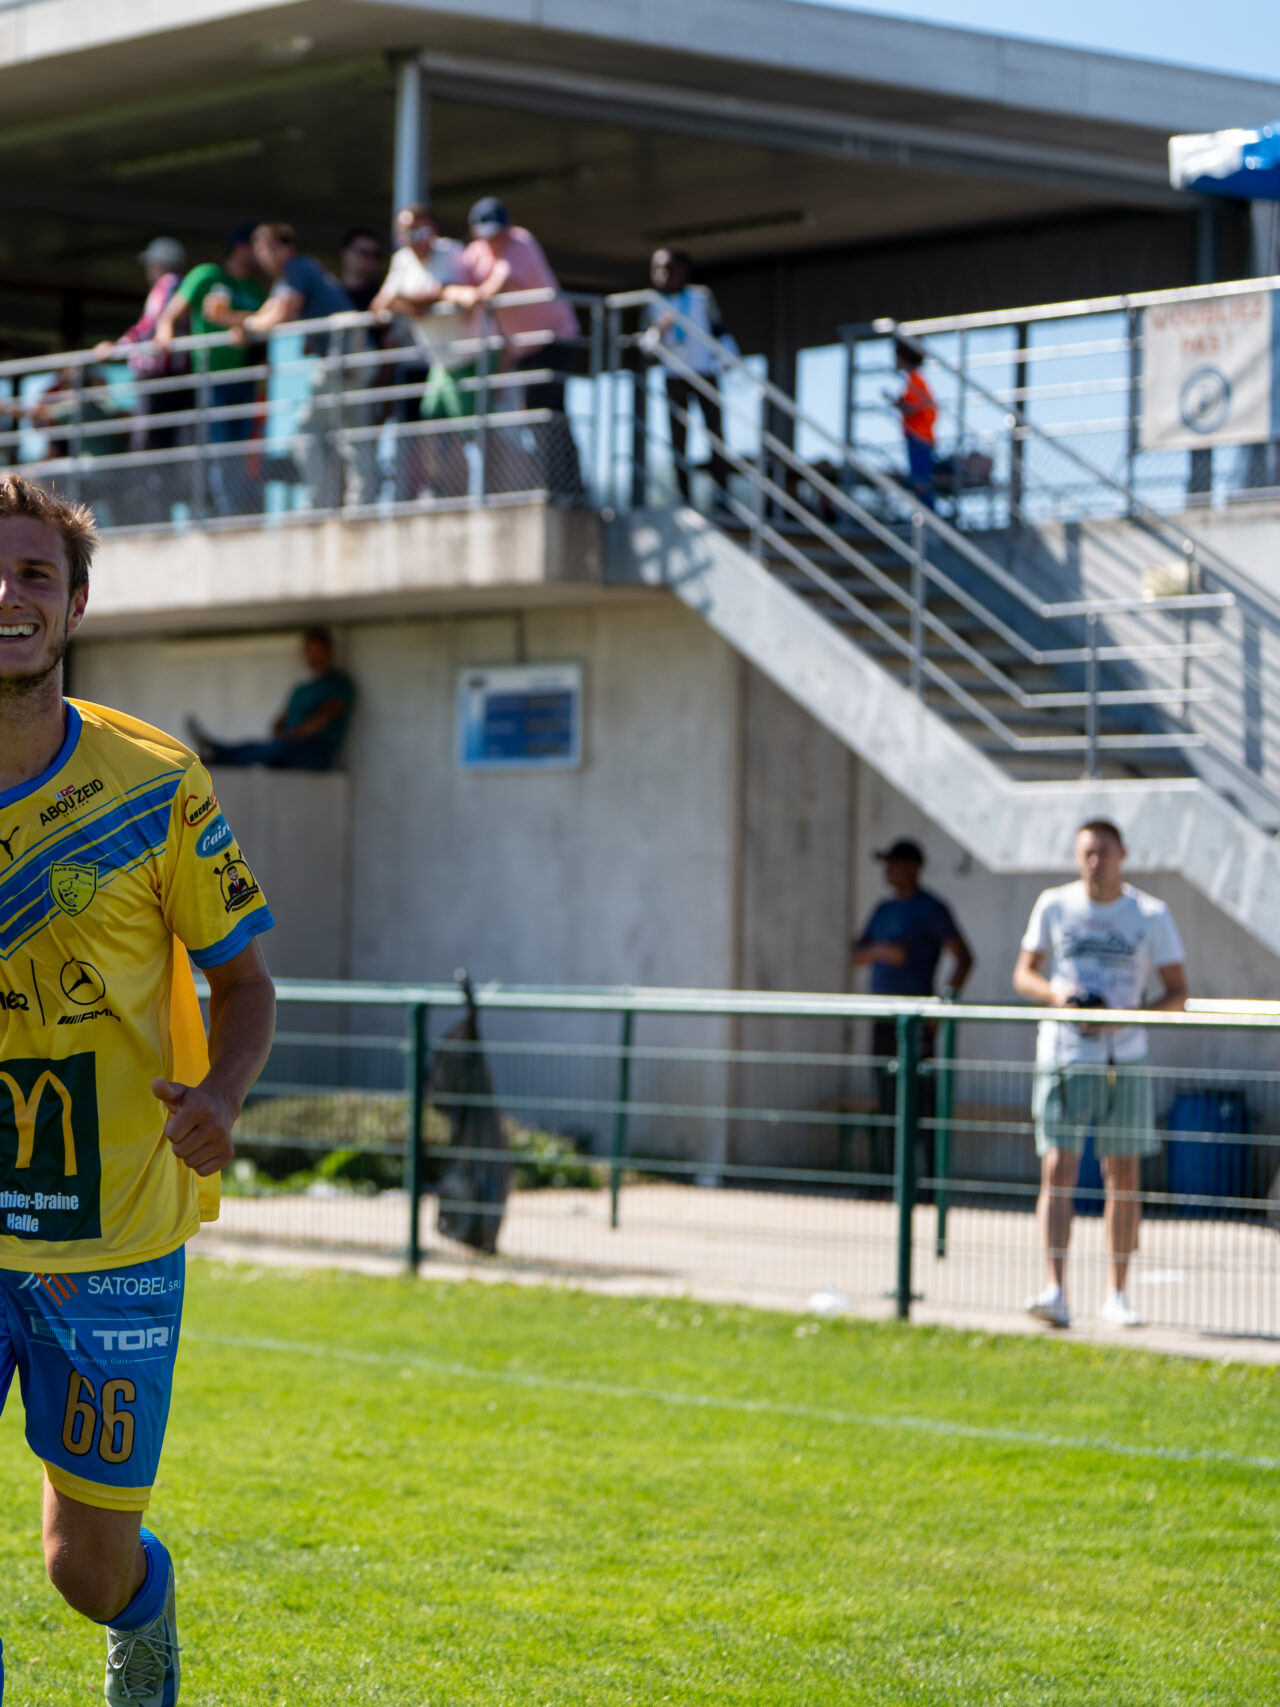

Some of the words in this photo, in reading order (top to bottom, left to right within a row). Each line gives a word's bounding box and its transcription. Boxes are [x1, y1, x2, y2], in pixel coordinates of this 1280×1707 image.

[202, 824, 231, 852] Cair
[6, 1213, 40, 1233] Halle
[87, 1275, 167, 1296] SATOBEL
[61, 1367, 137, 1464] 66
